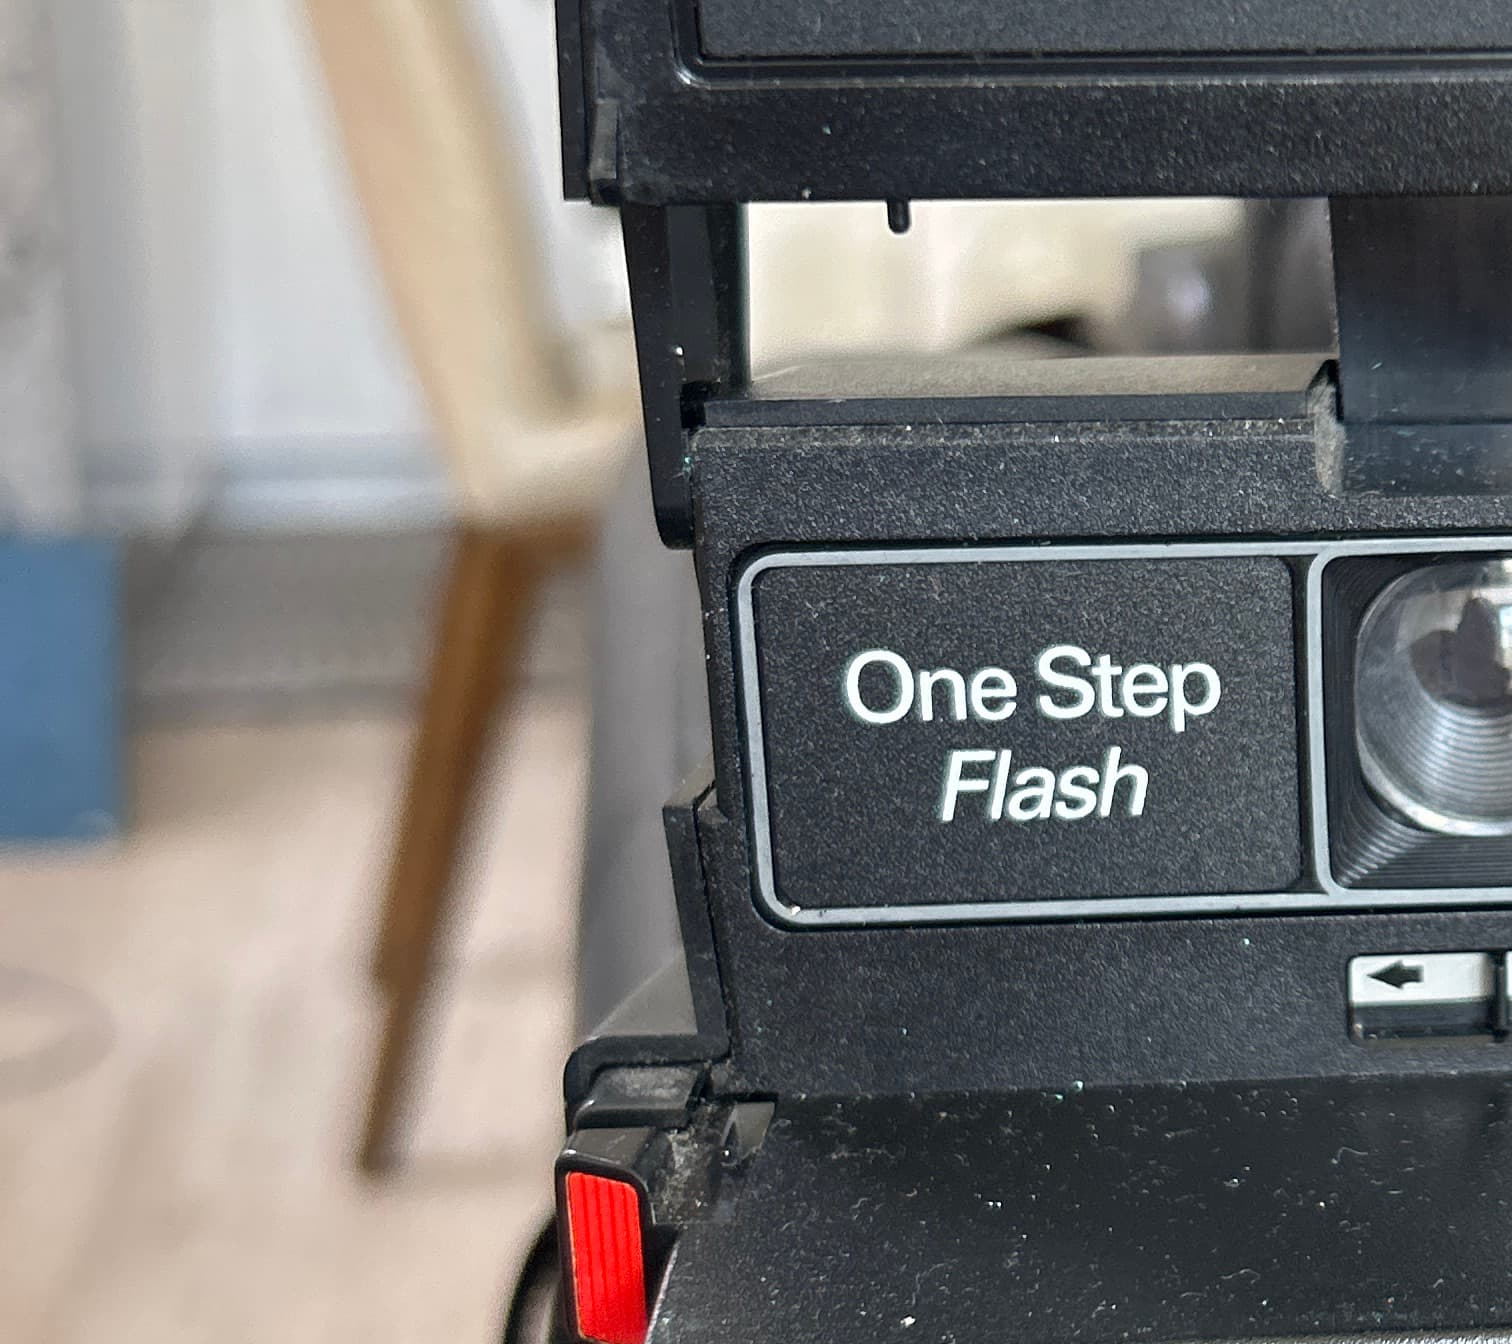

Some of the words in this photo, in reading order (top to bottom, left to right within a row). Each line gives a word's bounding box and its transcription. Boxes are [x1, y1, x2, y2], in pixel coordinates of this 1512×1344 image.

[841, 647, 1018, 725] One
[1033, 643, 1222, 735] Step
[937, 745, 1149, 824] Flash
